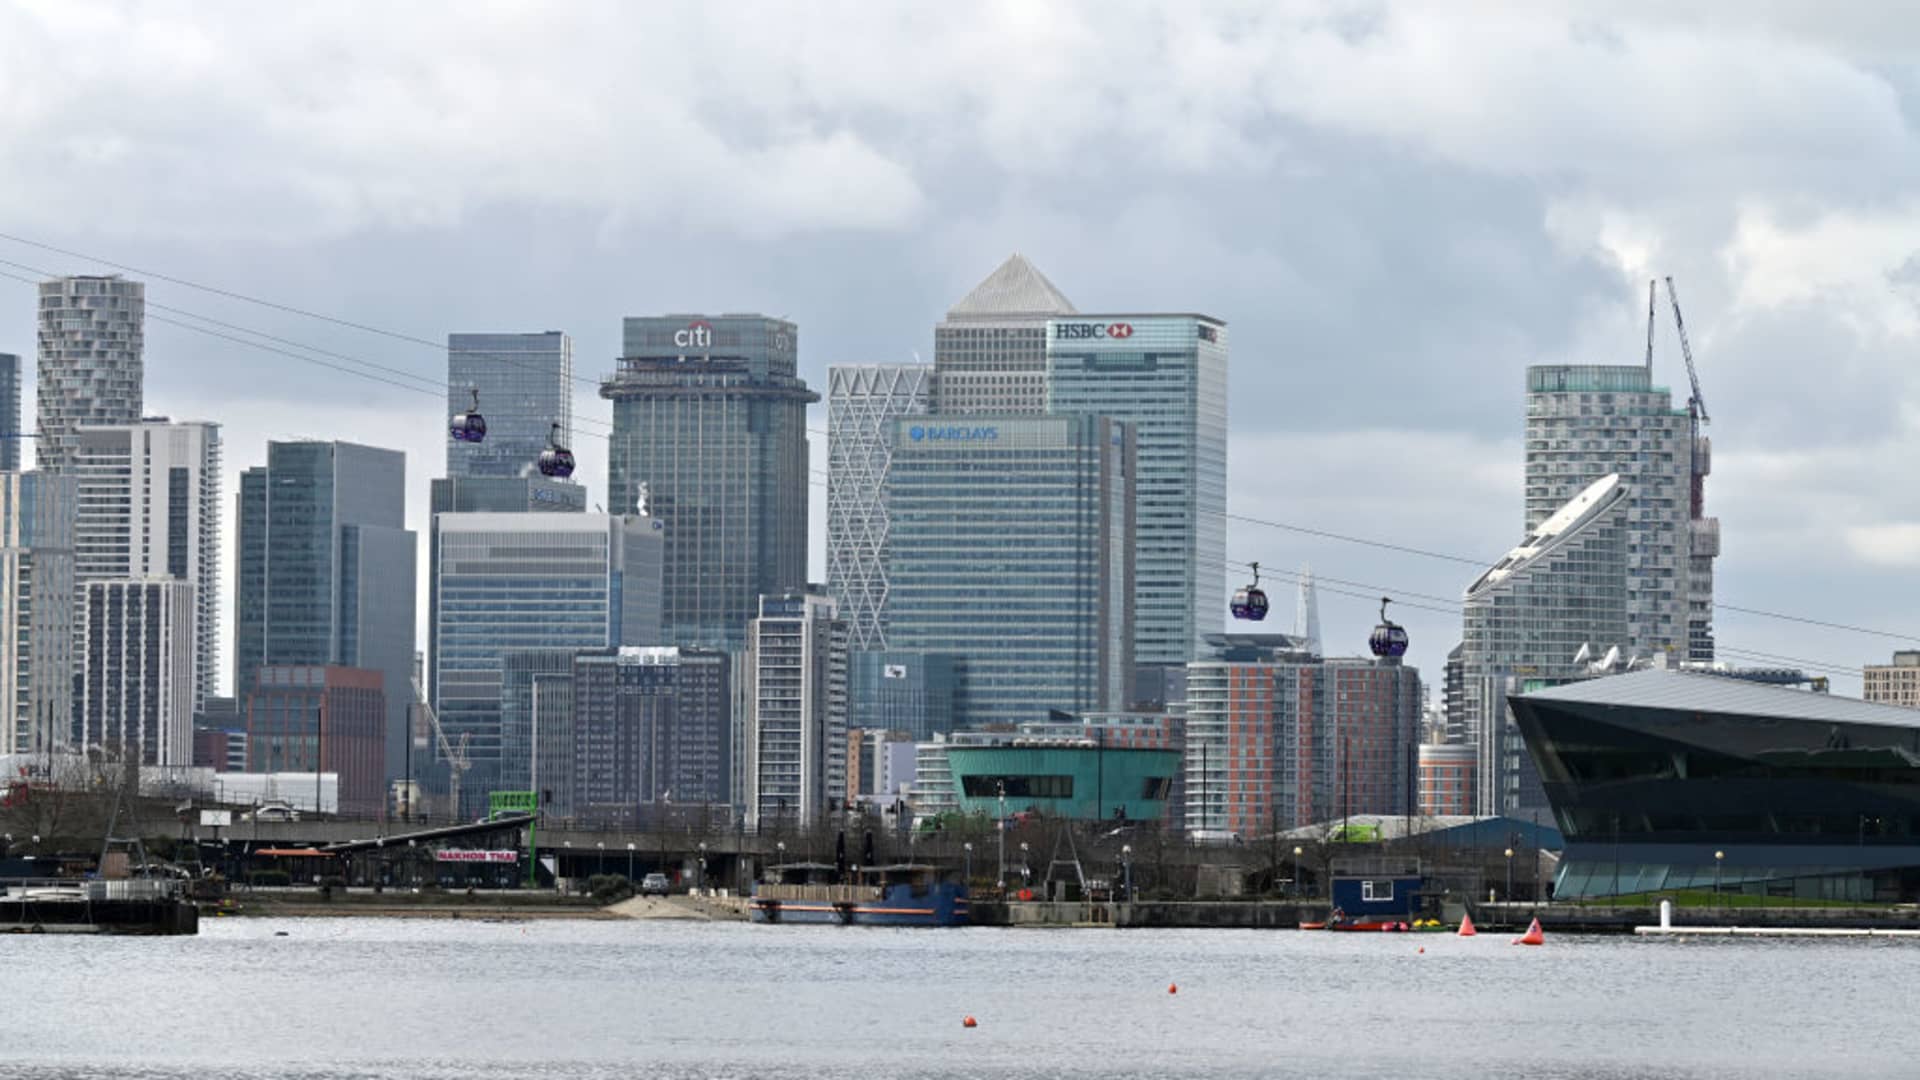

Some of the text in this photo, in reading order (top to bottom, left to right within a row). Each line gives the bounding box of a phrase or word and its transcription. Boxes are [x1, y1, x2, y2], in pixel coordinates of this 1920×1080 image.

[674, 324, 712, 347] citi
[1055, 323, 1105, 339] HSBC
[927, 426, 998, 440] BARCLAYS
